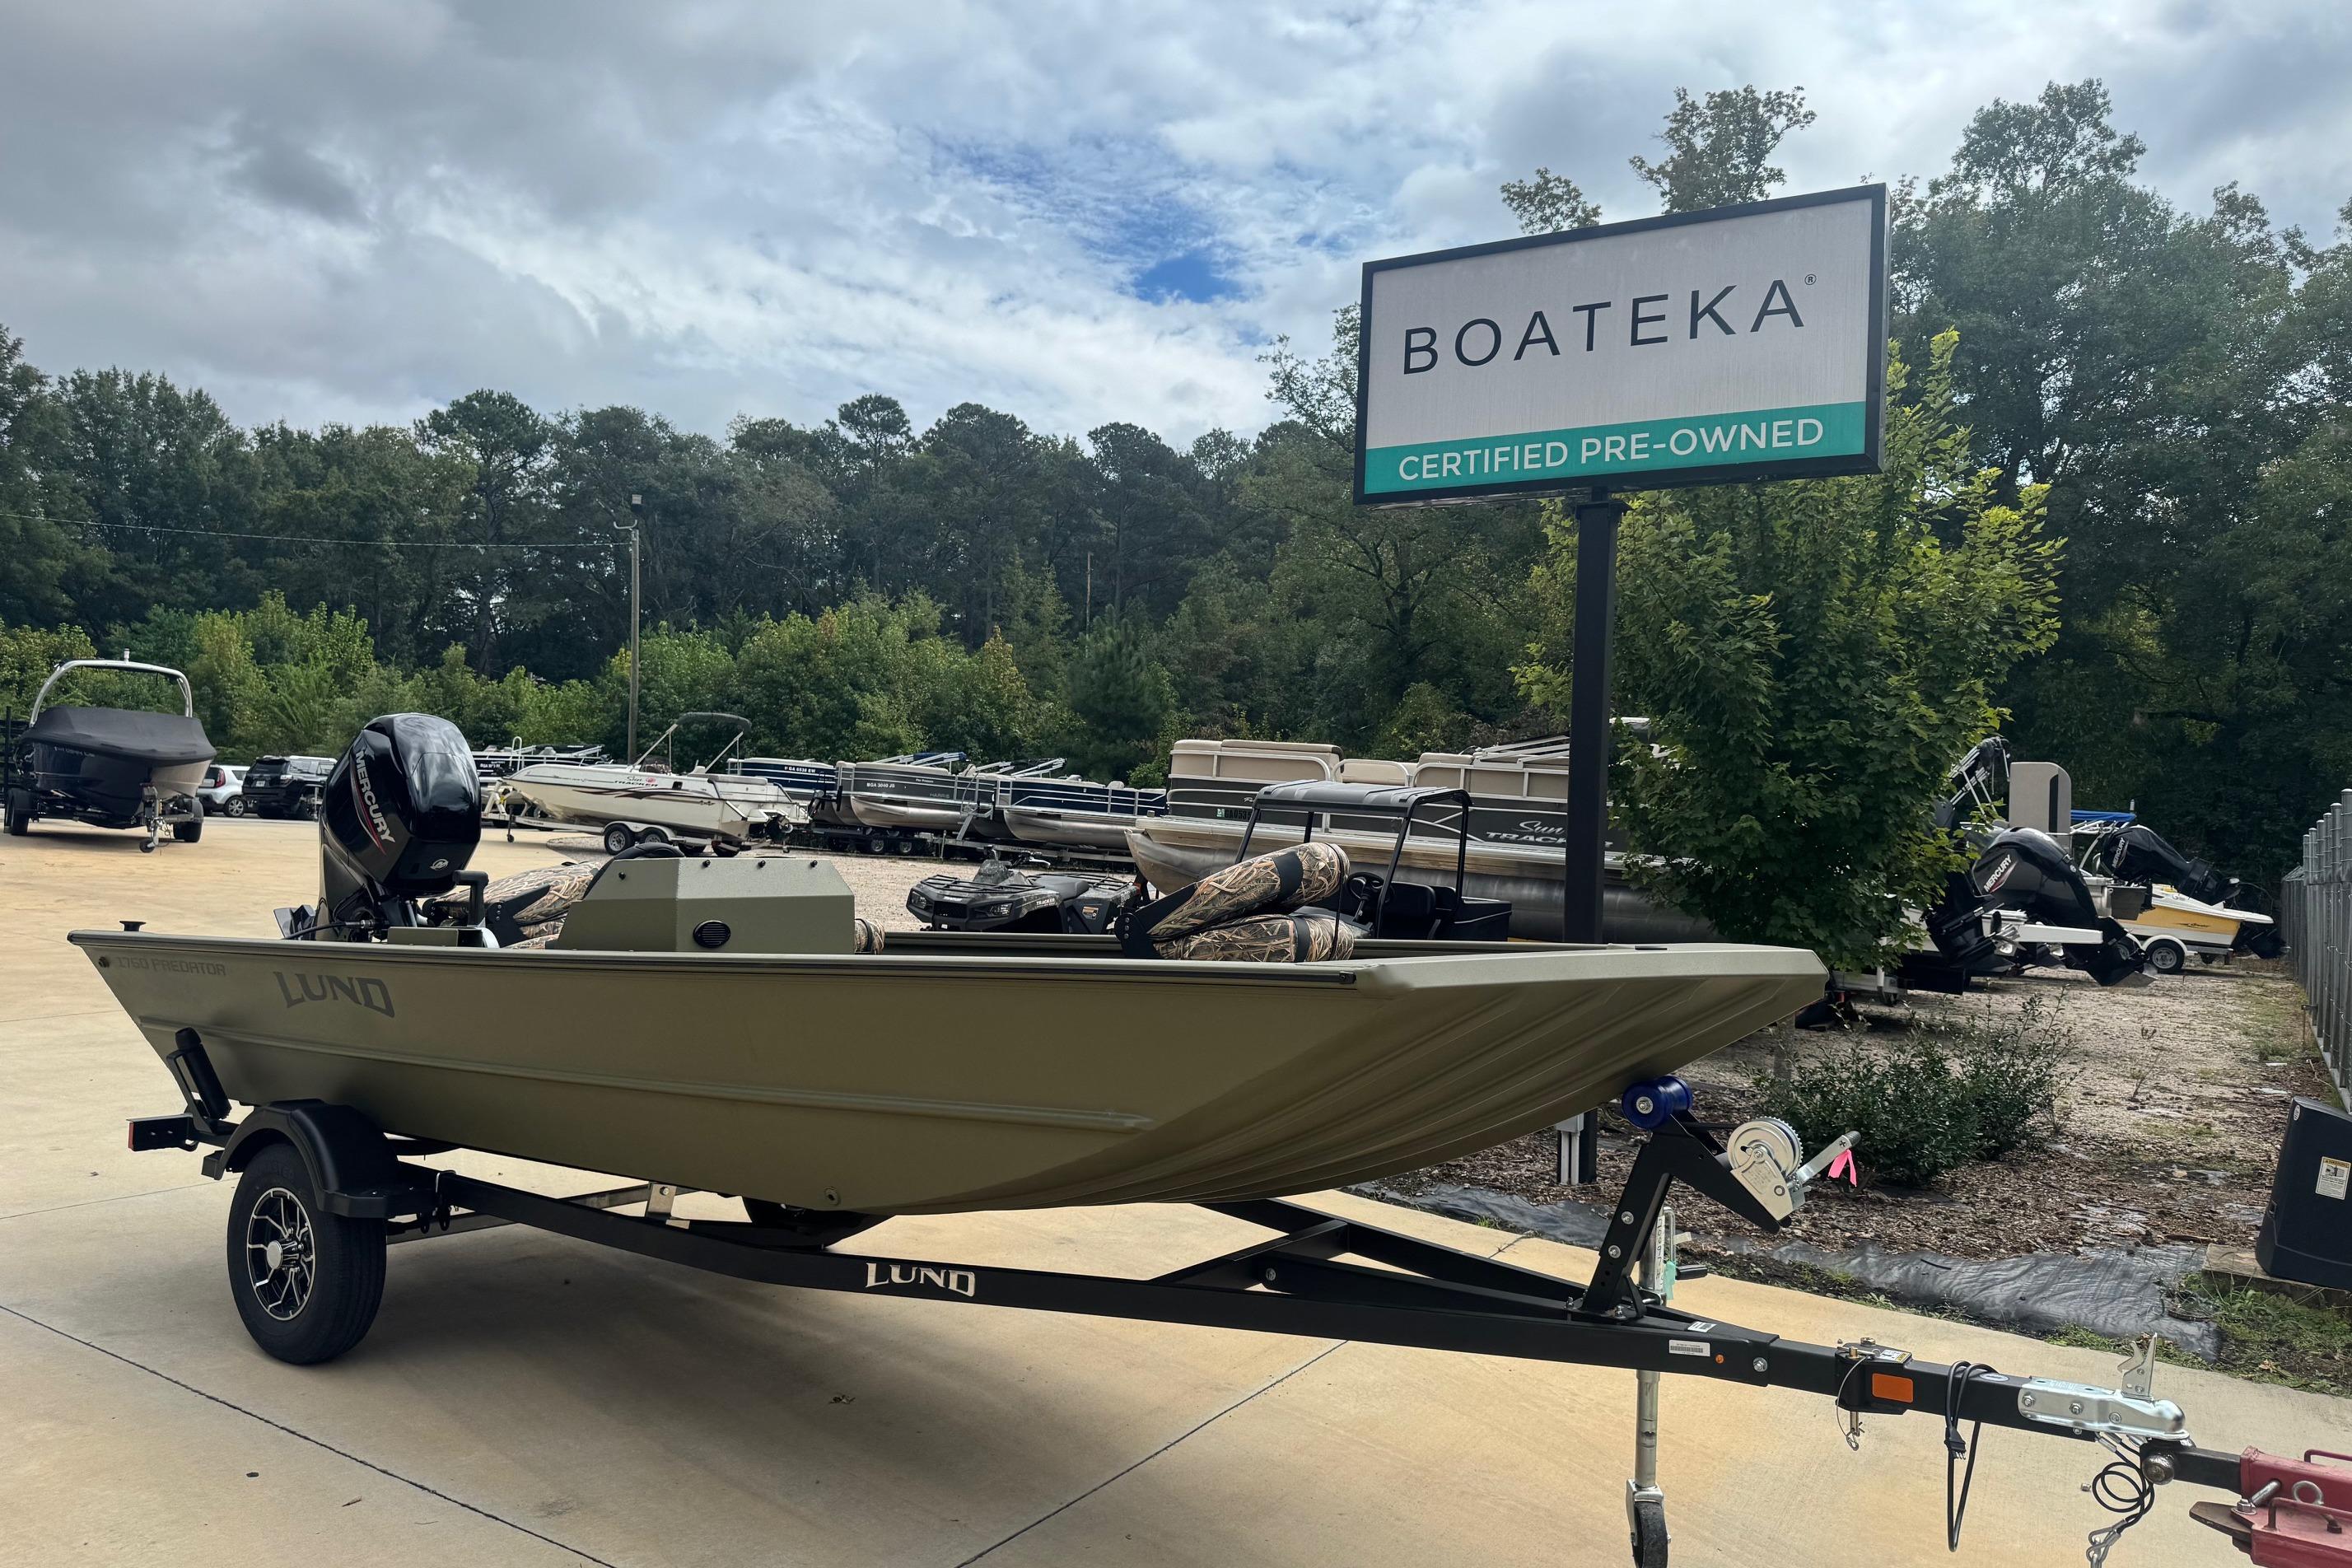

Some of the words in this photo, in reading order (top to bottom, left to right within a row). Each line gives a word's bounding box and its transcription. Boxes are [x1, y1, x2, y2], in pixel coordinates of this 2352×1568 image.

[1398, 441, 1568, 482] CERTIFIED
[1580, 418, 1824, 464] PRE-OWNED
[355, 748, 396, 843] MERCURY
[1512, 820, 1566, 835] Sun
[2112, 837, 2126, 868] MERCURY
[1983, 854, 2013, 893] MERCURY
[1036, 898, 1056, 906] TRACKER
[151, 958, 227, 976] PREDATOR
[273, 971, 395, 1019] LUND
[865, 1262, 976, 1297] LUND
